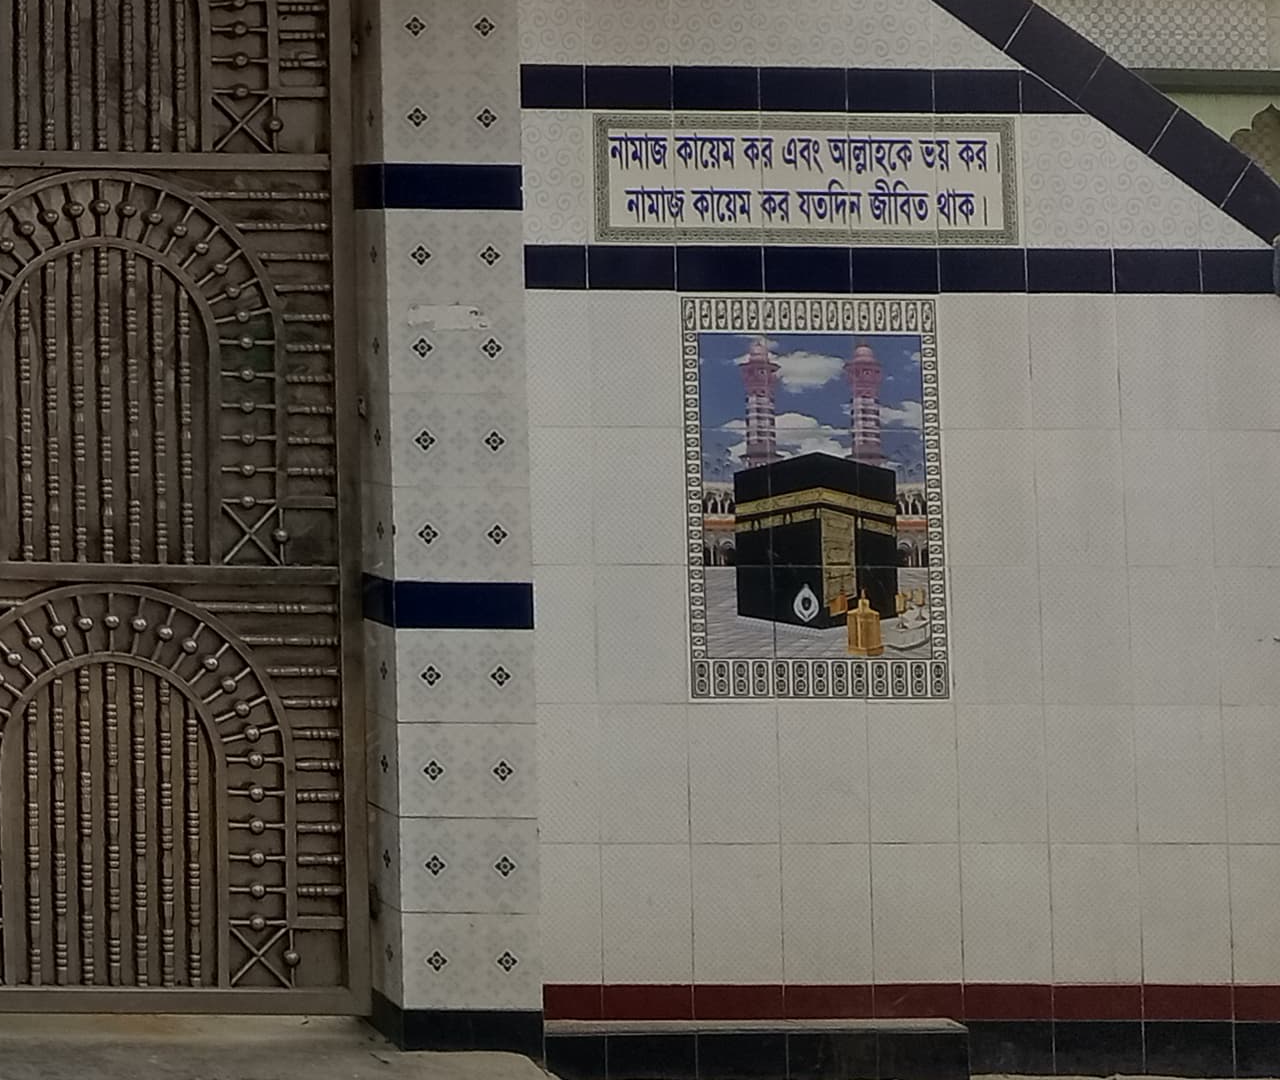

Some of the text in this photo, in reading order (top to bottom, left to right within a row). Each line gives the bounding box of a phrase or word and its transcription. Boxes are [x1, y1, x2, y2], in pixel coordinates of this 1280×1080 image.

[608, 132, 668, 170] নামাজ
[674, 132, 735, 171] কায়েম
[741, 136, 773, 169] কর
[782, 137, 823, 172] এবং
[827, 134, 912, 174] আল্লাহকে
[918, 138, 950, 172] ভয়
[625, 186, 685, 223] নামাজ
[691, 186, 751, 224] কায়েম
[760, 188, 790, 224] কর
[796, 179, 862, 224] যতদিন
[868, 179, 928, 224] জীবিত
